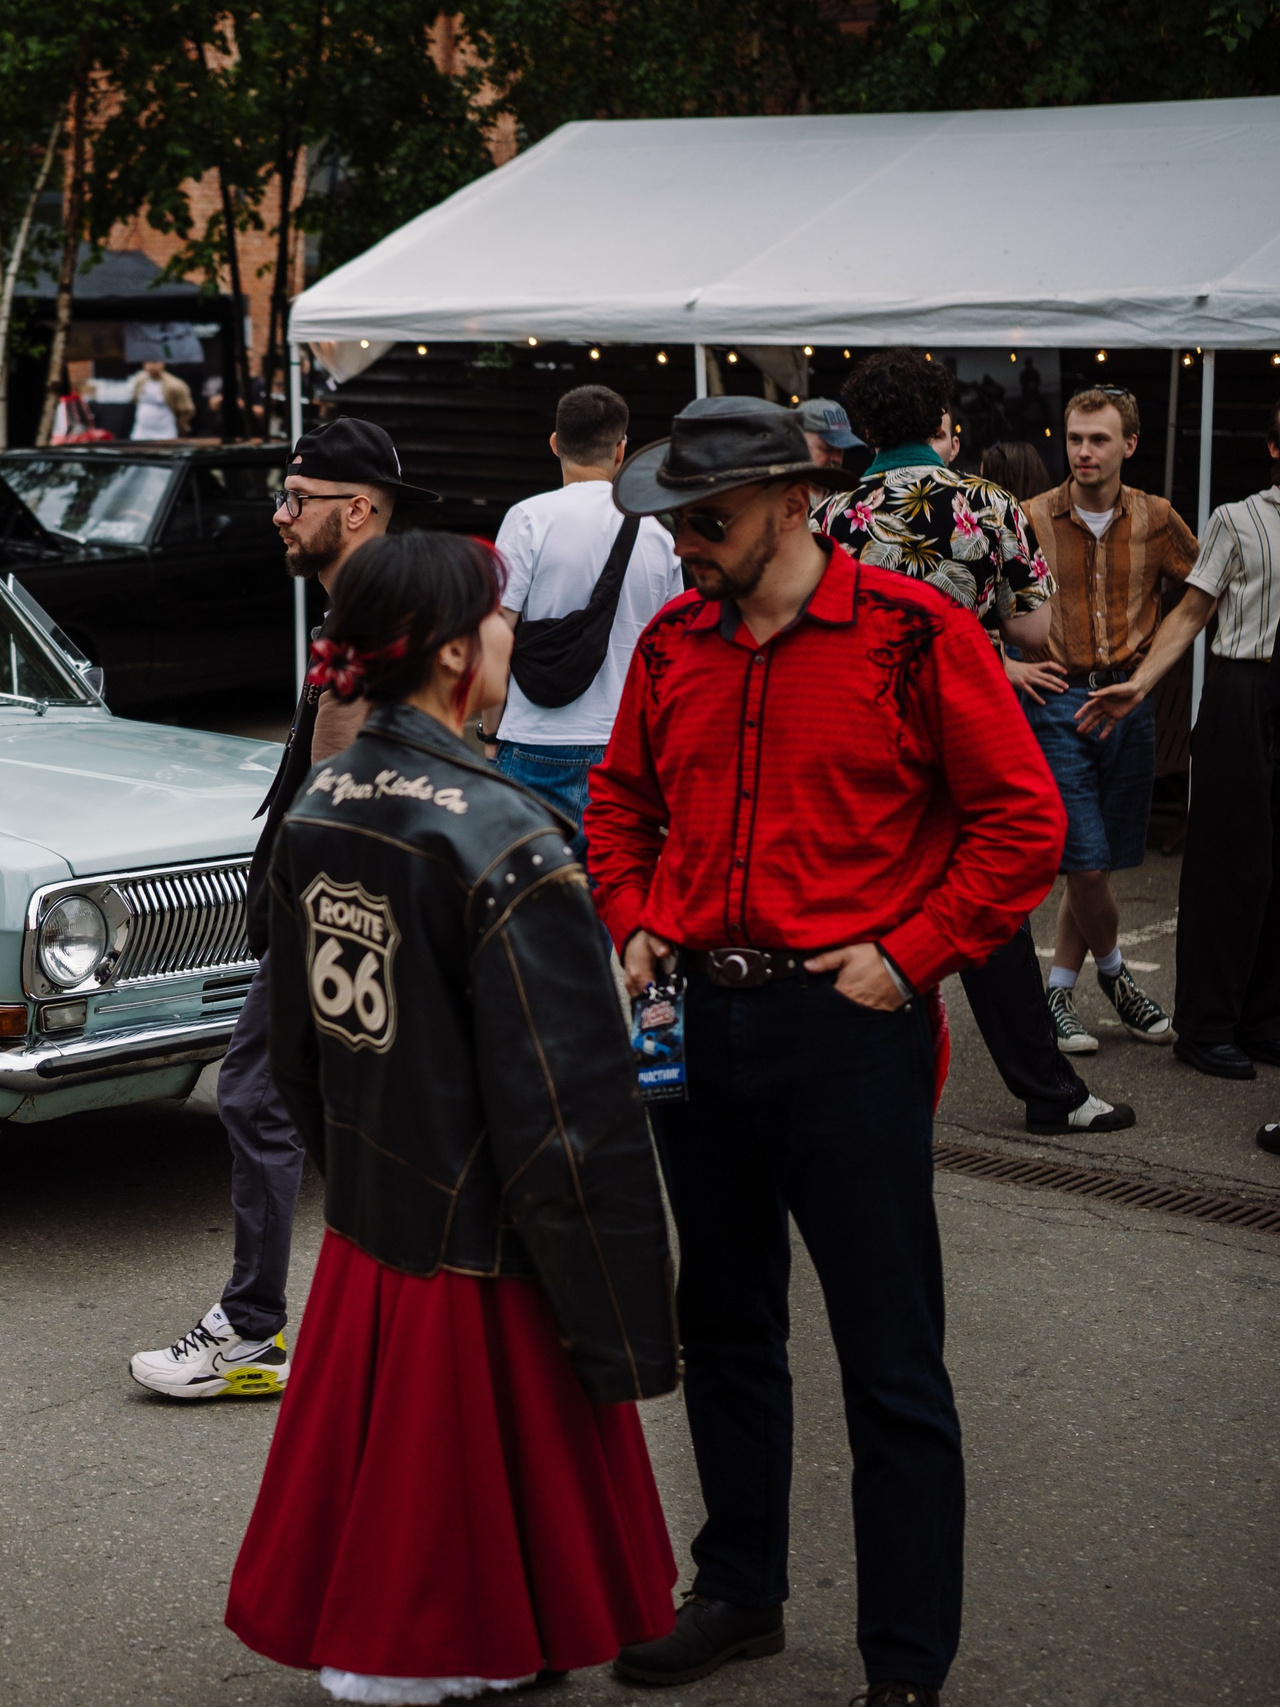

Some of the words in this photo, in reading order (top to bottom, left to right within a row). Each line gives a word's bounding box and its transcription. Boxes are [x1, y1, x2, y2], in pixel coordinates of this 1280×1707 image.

[433, 787, 469, 814] On
[319, 896, 384, 943] ROUTE
[311, 936, 387, 1032] 66
